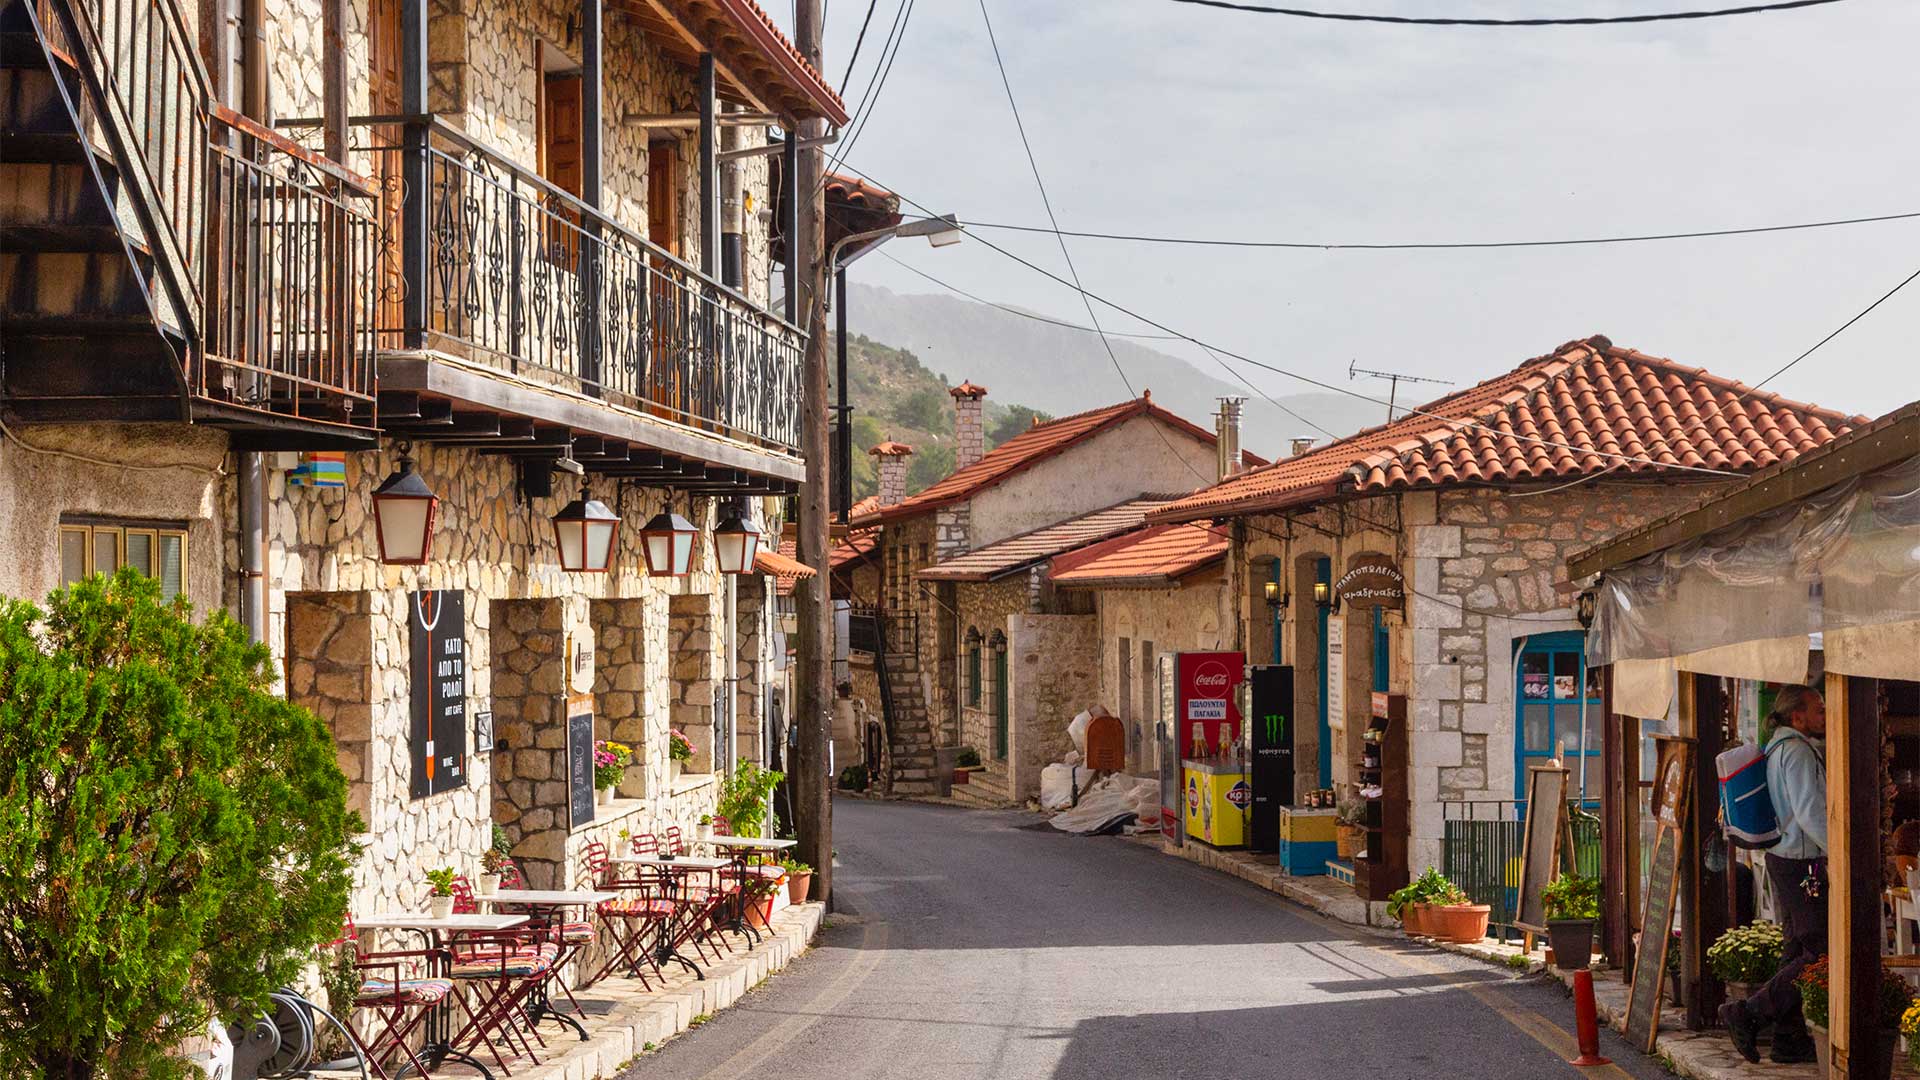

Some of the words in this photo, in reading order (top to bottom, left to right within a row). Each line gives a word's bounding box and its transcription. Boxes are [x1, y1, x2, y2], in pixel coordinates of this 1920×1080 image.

[1336, 565, 1403, 589] ΠΑΝΤΟΠΩΛΕΙΟΝ
[445, 638, 462, 654] ΚΑΤΩ
[438, 660, 452, 677] ΑΠΟ
[453, 659, 462, 675] ΤΟ
[1196, 674, 1227, 686] Coca-Cola
[1258, 748, 1291, 756] MONSTER
